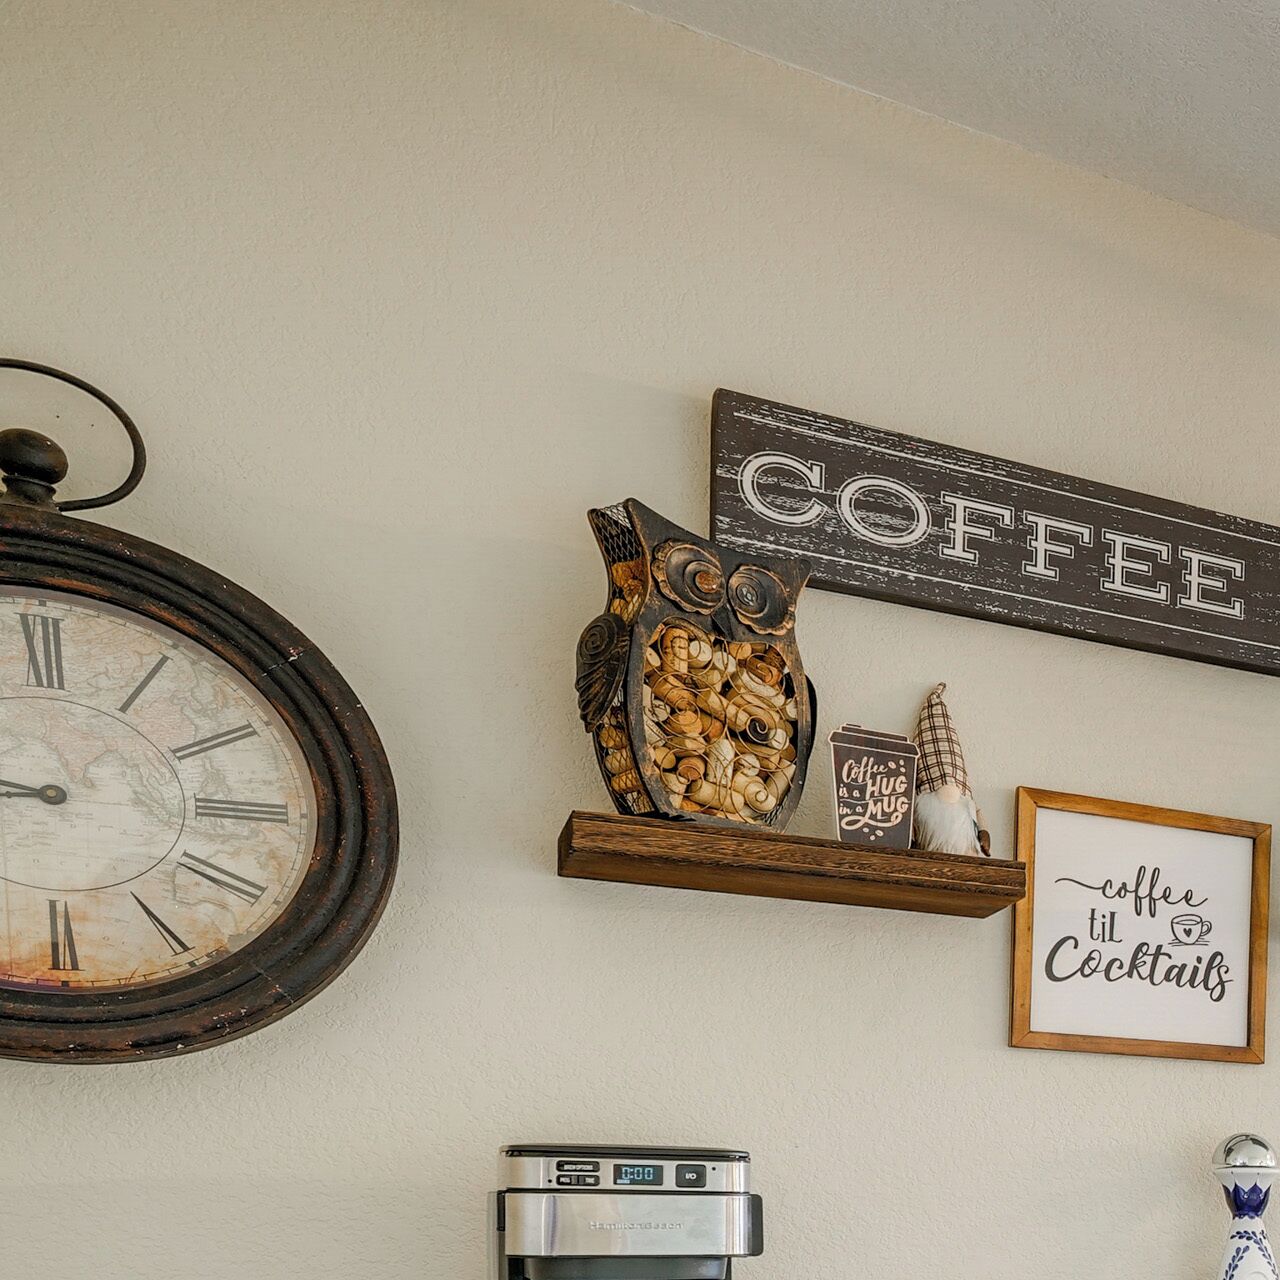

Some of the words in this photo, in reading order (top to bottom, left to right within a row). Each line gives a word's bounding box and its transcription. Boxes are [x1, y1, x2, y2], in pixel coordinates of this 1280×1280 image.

[737, 450, 1246, 619] COFFEE
[14, 611, 70, 693] XII
[839, 784, 849, 798] is
[852, 790, 861, 798] a
[866, 774, 908, 800] HUG
[842, 756, 888, 784] Coffee
[839, 803, 852, 815] in
[855, 804, 864, 813] a
[865, 796, 909, 820] MUG
[1054, 865, 1208, 918] coffee
[1044, 935, 1234, 1002] Cocktails
[621, 1167, 653, 1180] 0:00
